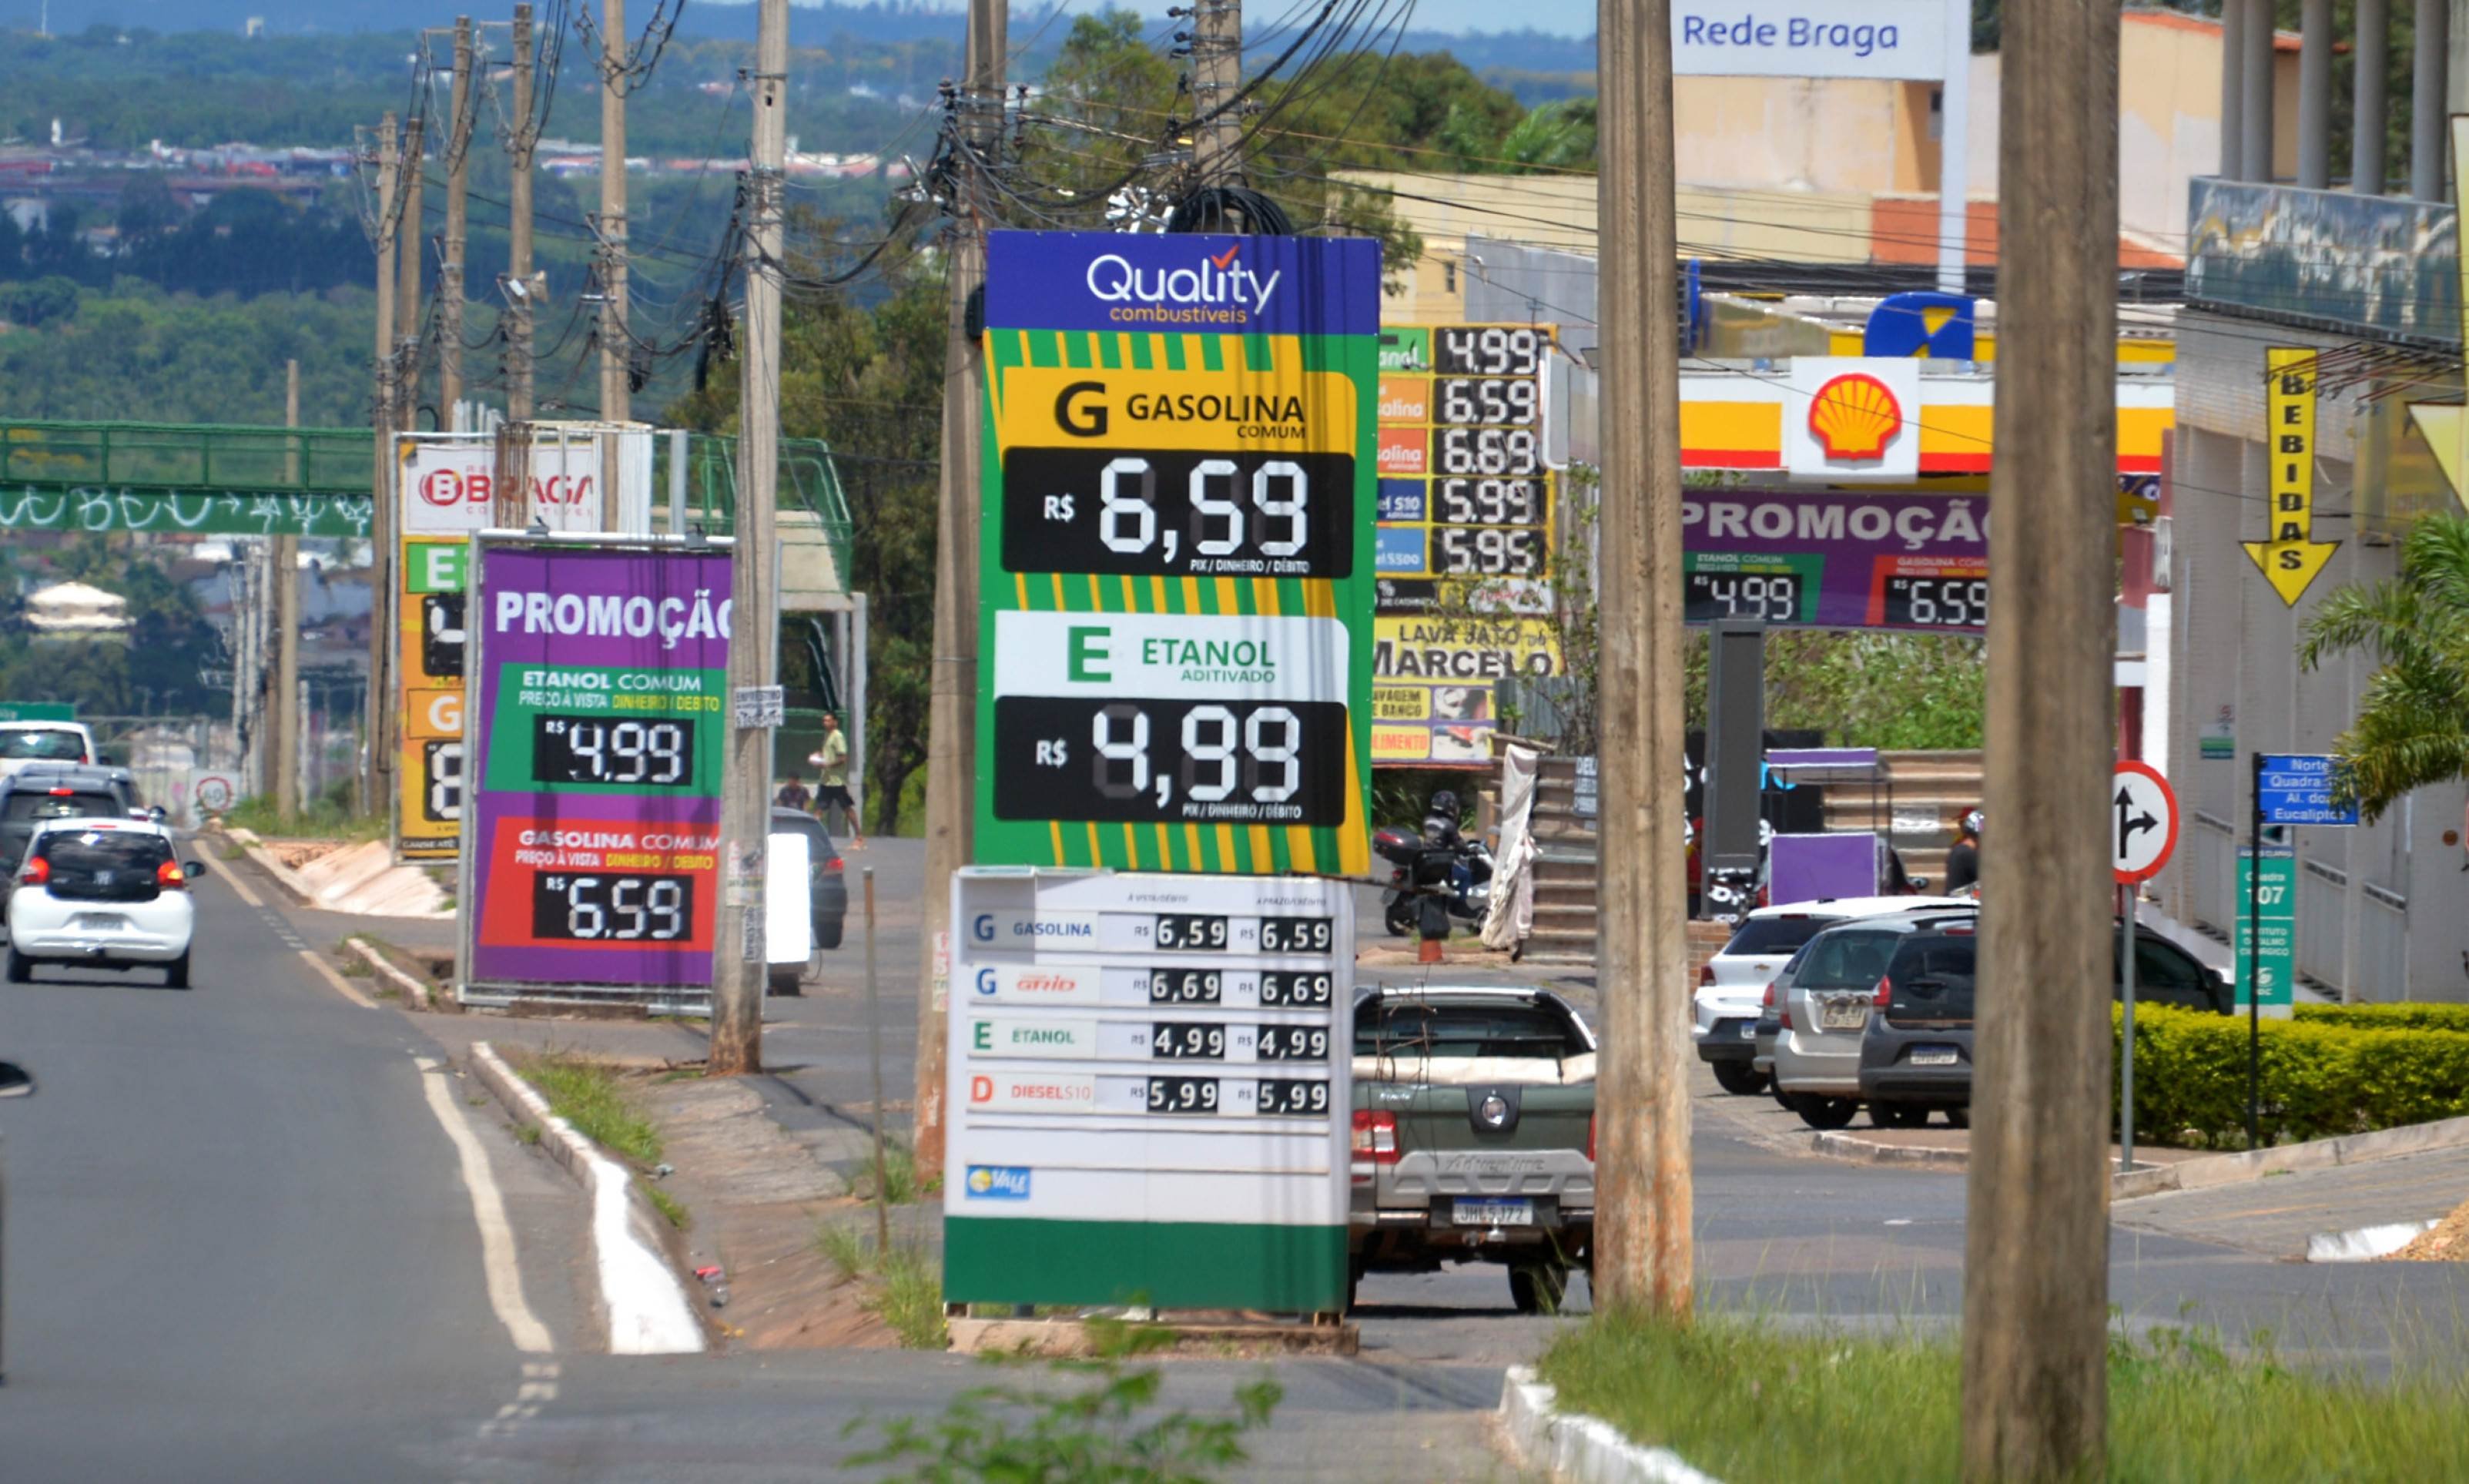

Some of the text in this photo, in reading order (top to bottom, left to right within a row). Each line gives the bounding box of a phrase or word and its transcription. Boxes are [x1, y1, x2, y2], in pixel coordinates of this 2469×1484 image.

[1684, 15, 1898, 57] Rede Braga
[1087, 253, 1281, 315] Quality
[1110, 303, 1247, 323] combustíveis
[1379, 347, 1419, 367] anol
[1054, 381, 1109, 437] G
[1126, 394, 1305, 422] GASOLINA
[1237, 425, 1305, 439] COMUM
[1044, 457, 1308, 563] R$ 6,59
[1682, 499, 1990, 550] PROMOÇÃ
[1190, 559, 1206, 571] PIX
[1216, 560, 1264, 572] DINHEIRO
[1273, 557, 1310, 573] DÉBITO
[1697, 554, 1739, 563] ETANOL
[1399, 625, 1456, 644] LAVA
[1067, 626, 1111, 682] E
[1142, 638, 1276, 668] ETANOL
[523, 671, 702, 692] ETANOL COMUM
[1181, 669, 1275, 683] ADITIVADO
[519, 691, 560, 709] PREÇO
[573, 693, 608, 709] VISTA
[612, 695, 667, 710] DINHEIRO
[1372, 688, 1421, 702] AVAGEM
[545, 721, 565, 734] R$
[1372, 733, 1428, 751] LIMENTO
[1036, 705, 1301, 809] R$ 4,99
[2290, 759, 2330, 771] Norte
[2270, 775, 2321, 788] Quadra
[1182, 803, 1198, 817] PIX
[1208, 803, 1257, 818] DINHEIRO
[1265, 802, 1302, 819] DÉBITO
[2309, 792, 2331, 804] do
[518, 829, 724, 851] GASOLINA COMUM
[515, 850, 555, 868] PREÇO
[568, 853, 600, 867] VISTA
[605, 853, 662, 868] DINHEIRO
[546, 877, 566, 891] R$
[973, 914, 1092, 941] G GASOLINA
[1134, 920, 1226, 949] R$ 6,59
[1240, 923, 1330, 952] R$ 6,59
[975, 967, 997, 995] G
[1134, 972, 1221, 1003] R$ 6,69
[1239, 974, 1331, 1003] R$ 6,69
[973, 1021, 1075, 1050] E ETANOL
[1131, 1026, 1224, 1057] R$ 4,99
[1238, 1028, 1327, 1060] R$ 4,99
[970, 1075, 993, 1102] D
[1131, 1080, 1218, 1111] R$ 5,99
[1238, 1082, 1327, 1113] R$ 5,99
